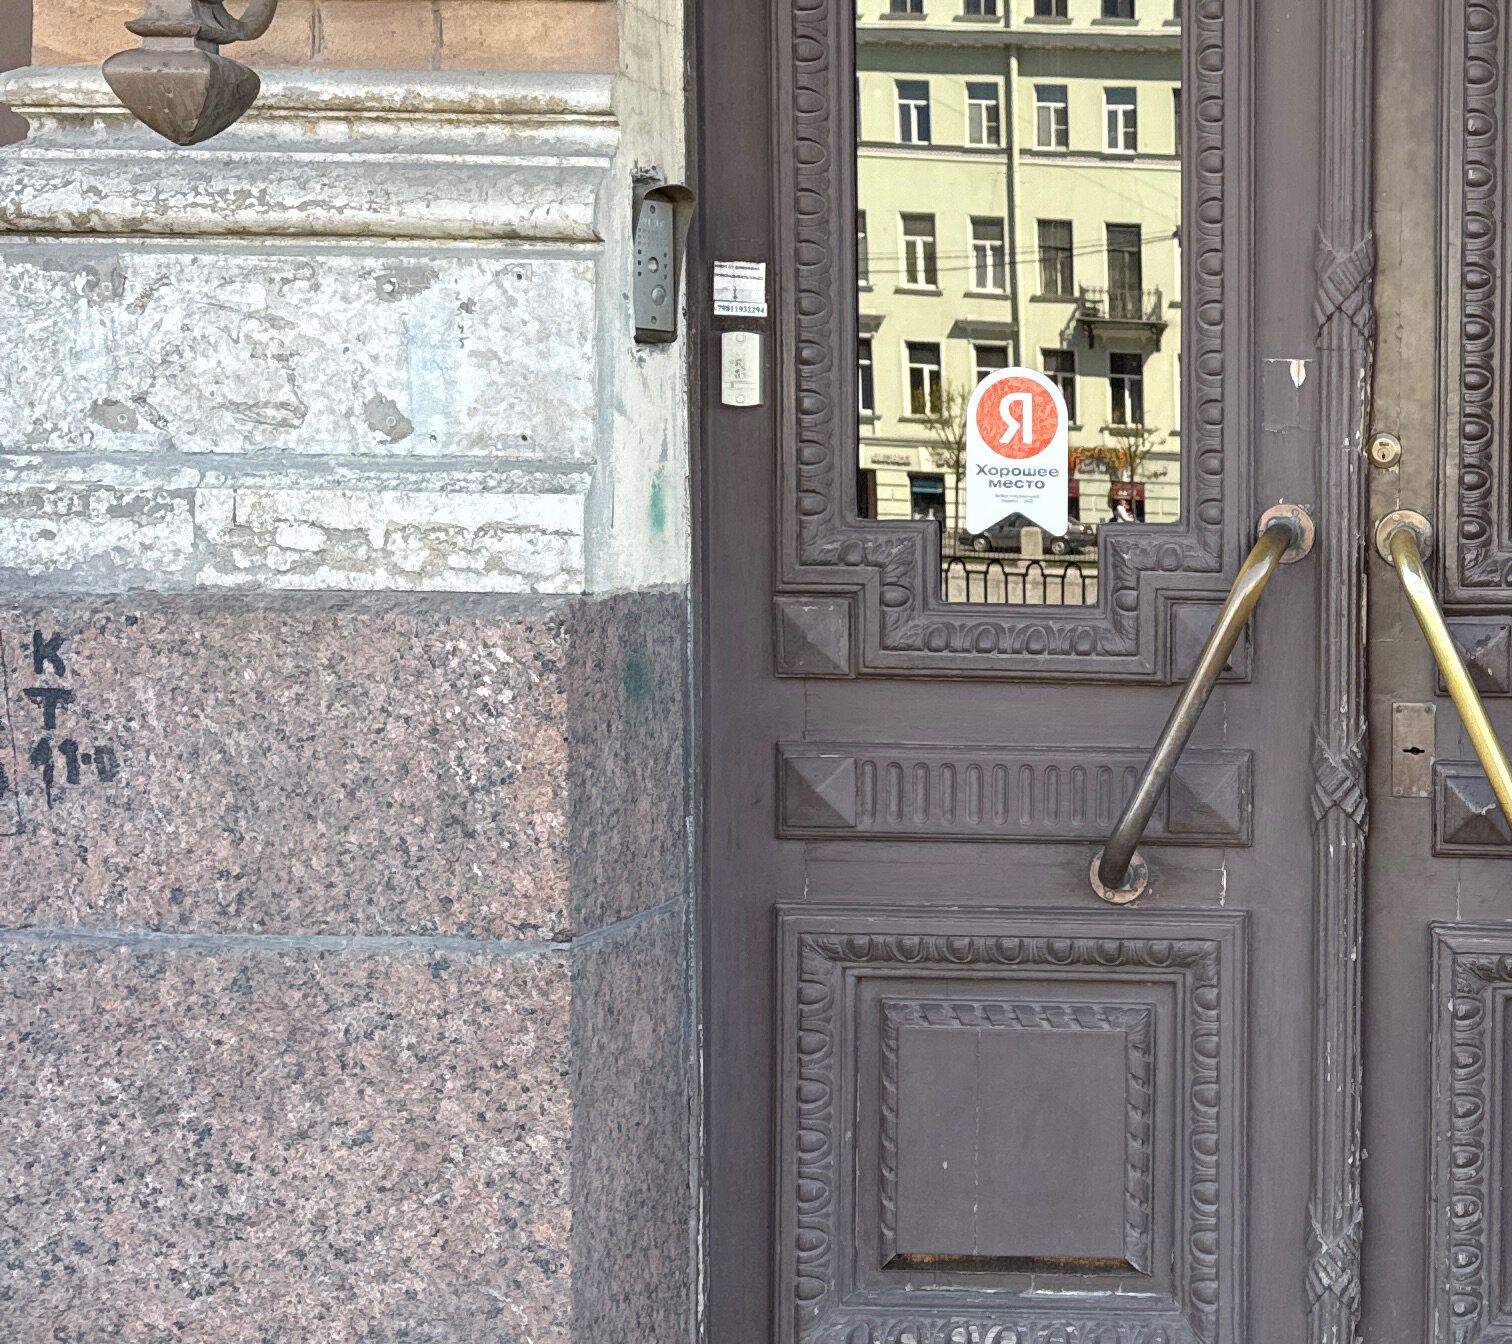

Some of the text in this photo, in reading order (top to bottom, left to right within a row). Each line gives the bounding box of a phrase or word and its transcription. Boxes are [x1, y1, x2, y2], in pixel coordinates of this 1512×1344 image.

[998, 392, 1034, 445] Я
[975, 463, 1060, 479] Хорошее
[988, 478, 1046, 490] место
